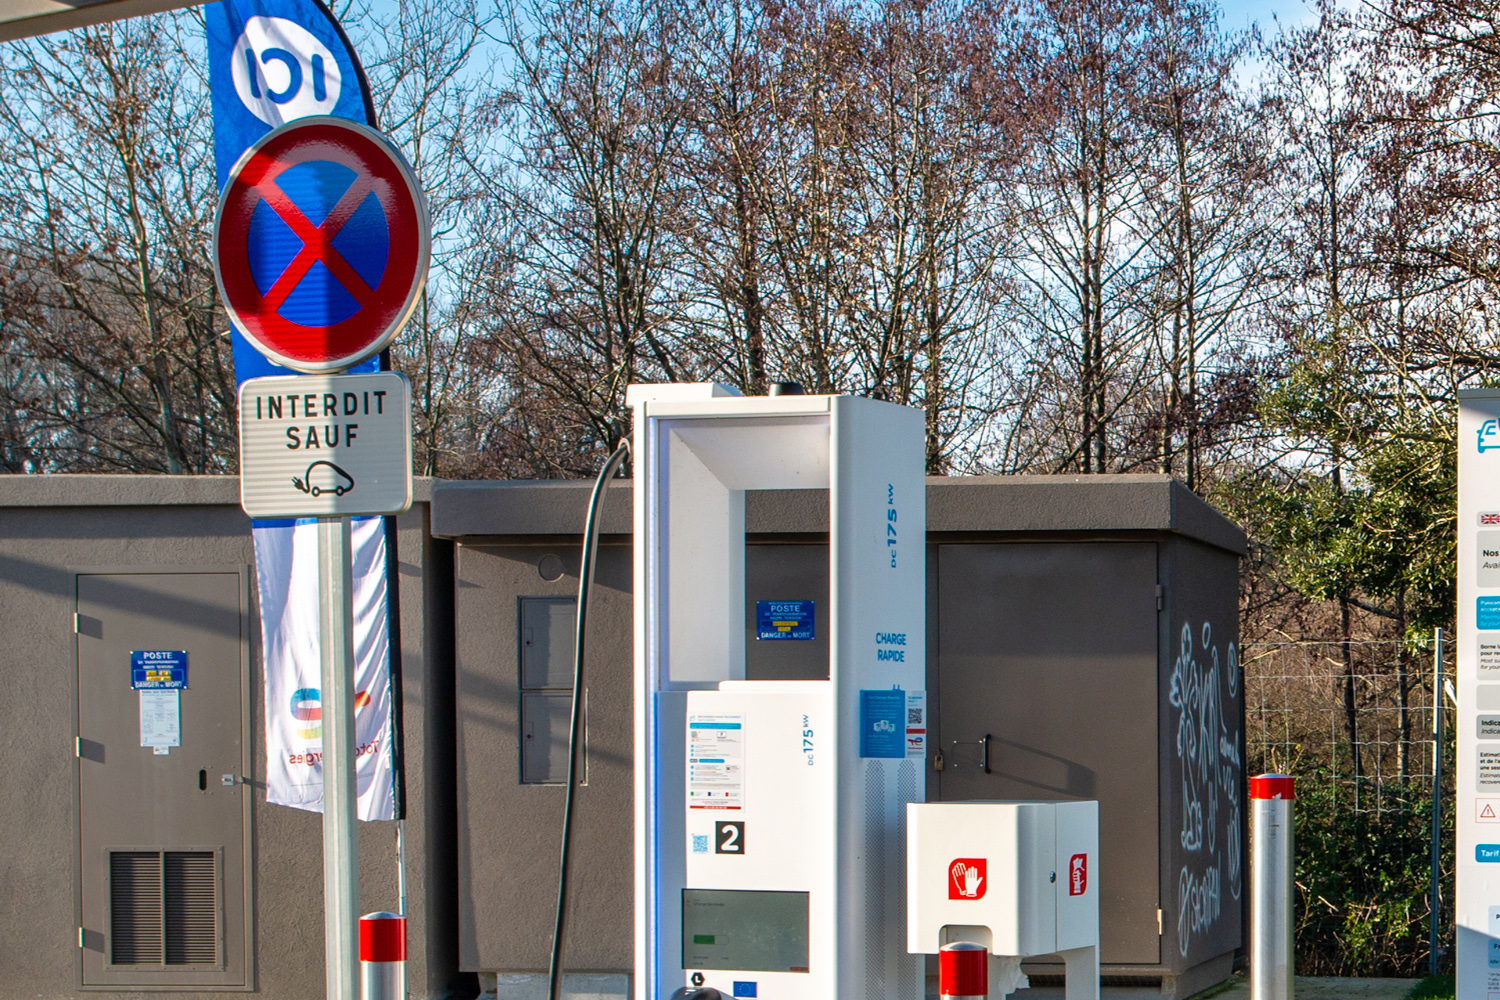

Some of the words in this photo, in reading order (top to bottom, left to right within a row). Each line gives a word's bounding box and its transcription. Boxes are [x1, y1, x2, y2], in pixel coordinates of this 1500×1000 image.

[256, 391, 386, 419] INTERDIT
[286, 424, 358, 450] SAUF
[888, 483, 894, 505] kW
[887, 509, 897, 547] 175
[891, 550, 897, 568] DC
[1483, 549, 1499, 557] Nos
[876, 632, 907, 646] CHARGE
[143, 652, 173, 660] POSTE
[877, 649, 905, 662] RAPIDE
[802, 714, 809, 728] kW
[802, 729, 814, 753] 175
[807, 754, 814, 766] DC
[721, 824, 739, 851] 2
[1481, 849, 1499, 857] Tarif
[695, 975, 701, 983] L
